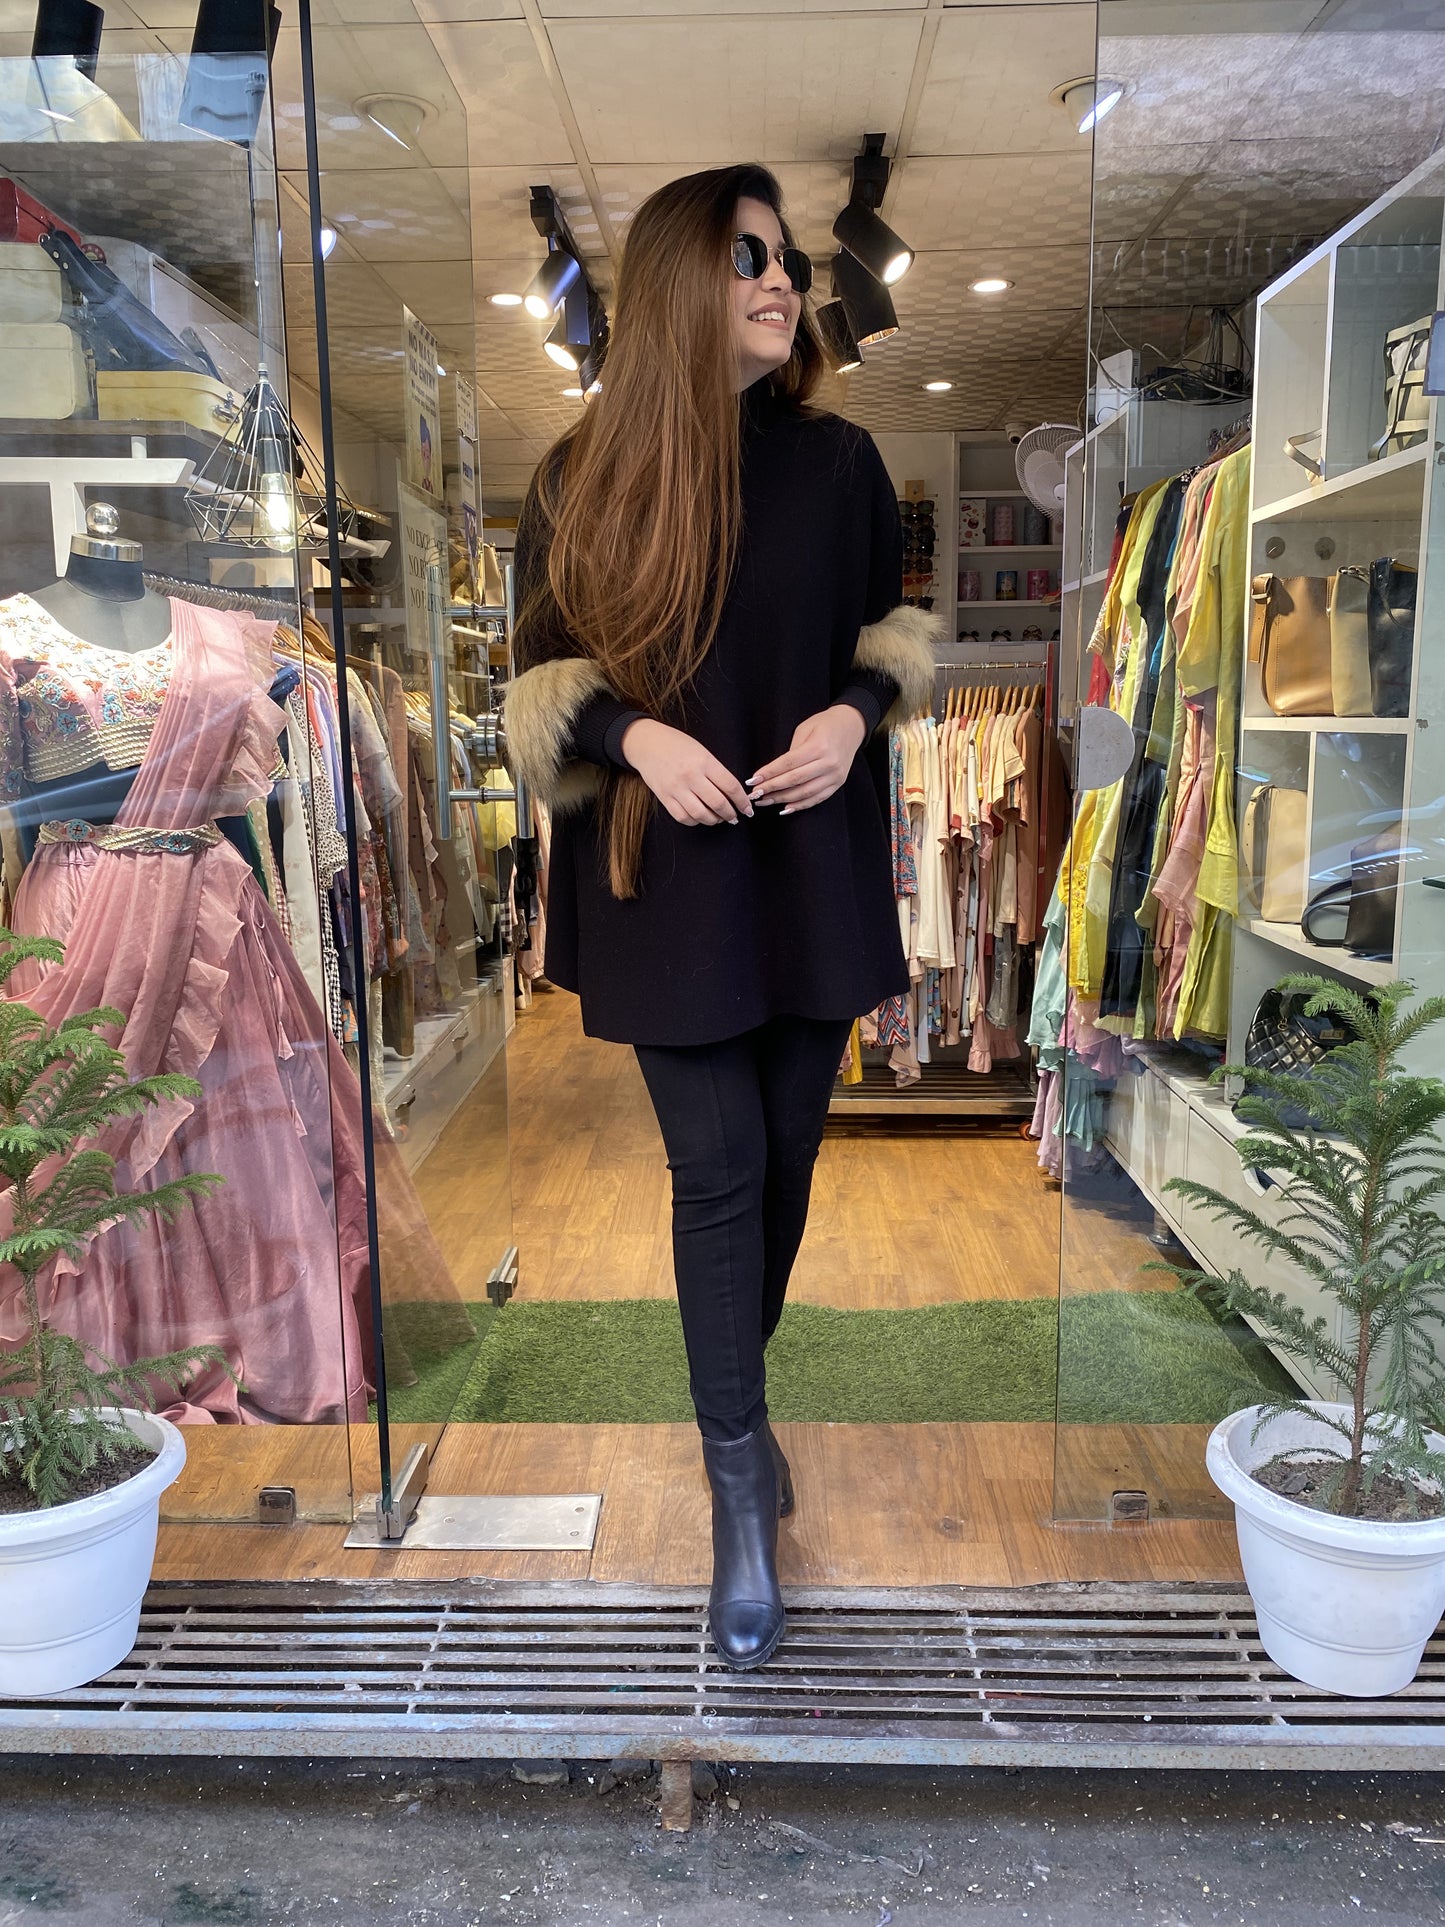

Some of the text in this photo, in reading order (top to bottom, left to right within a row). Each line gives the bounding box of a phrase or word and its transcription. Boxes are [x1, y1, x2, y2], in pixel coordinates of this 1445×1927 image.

[408, 329, 418, 353] NO
[409, 354, 418, 376] NO
[418, 362, 436, 392] ENTRY
[406, 525, 415, 545] NO
[408, 554, 419, 577] NO
[410, 587, 421, 609] NO
